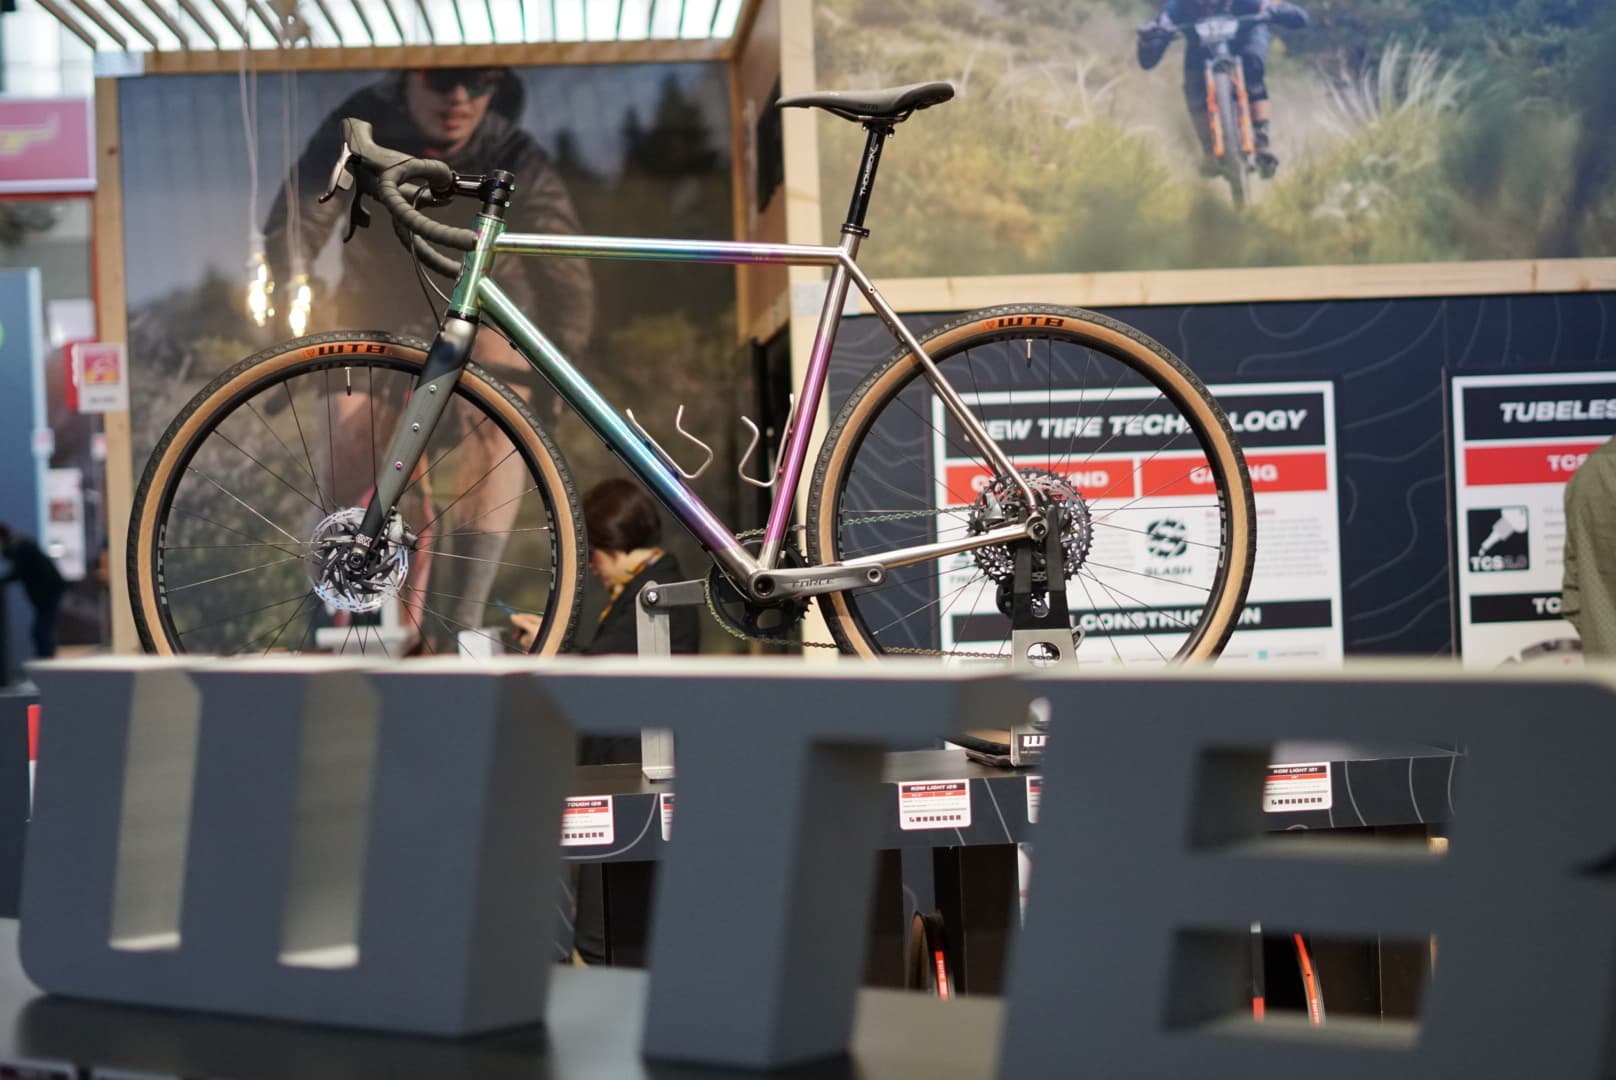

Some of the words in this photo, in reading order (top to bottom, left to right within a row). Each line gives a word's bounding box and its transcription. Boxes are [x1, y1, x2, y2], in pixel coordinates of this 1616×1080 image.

[997, 316, 1064, 328] WTB
[318, 343, 386, 356] WTB
[1037, 414, 1104, 439] TIRE
[1109, 409, 1307, 437] TECHLOGY
[1080, 607, 1262, 632] CONSTRUCN
